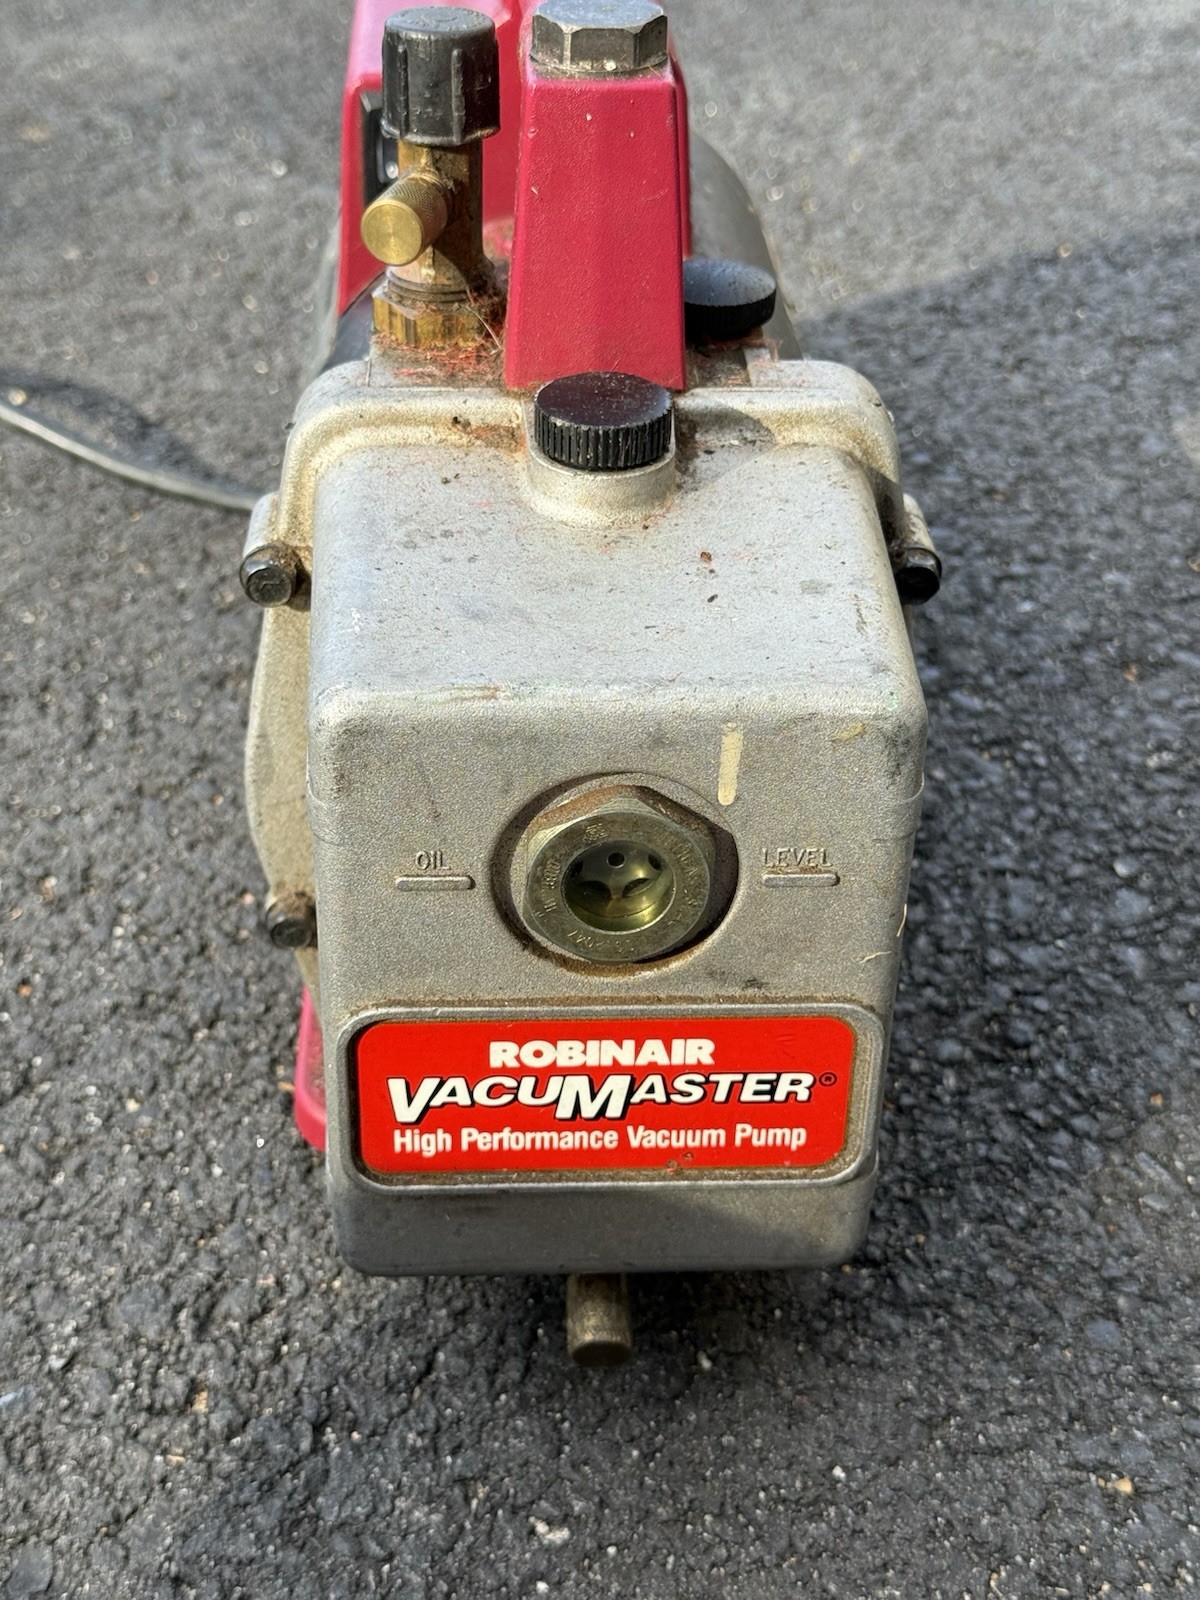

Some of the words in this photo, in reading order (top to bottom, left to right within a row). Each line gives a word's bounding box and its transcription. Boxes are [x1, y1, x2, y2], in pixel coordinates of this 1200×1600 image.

[415, 850, 451, 870] OIL
[762, 848, 833, 867] LEVEL
[489, 1039, 715, 1068] ROBINAIR
[393, 1128, 452, 1158] High
[461, 1126, 618, 1151] Performance
[626, 1124, 726, 1149] Vacuum
[734, 1123, 807, 1151] Pump
